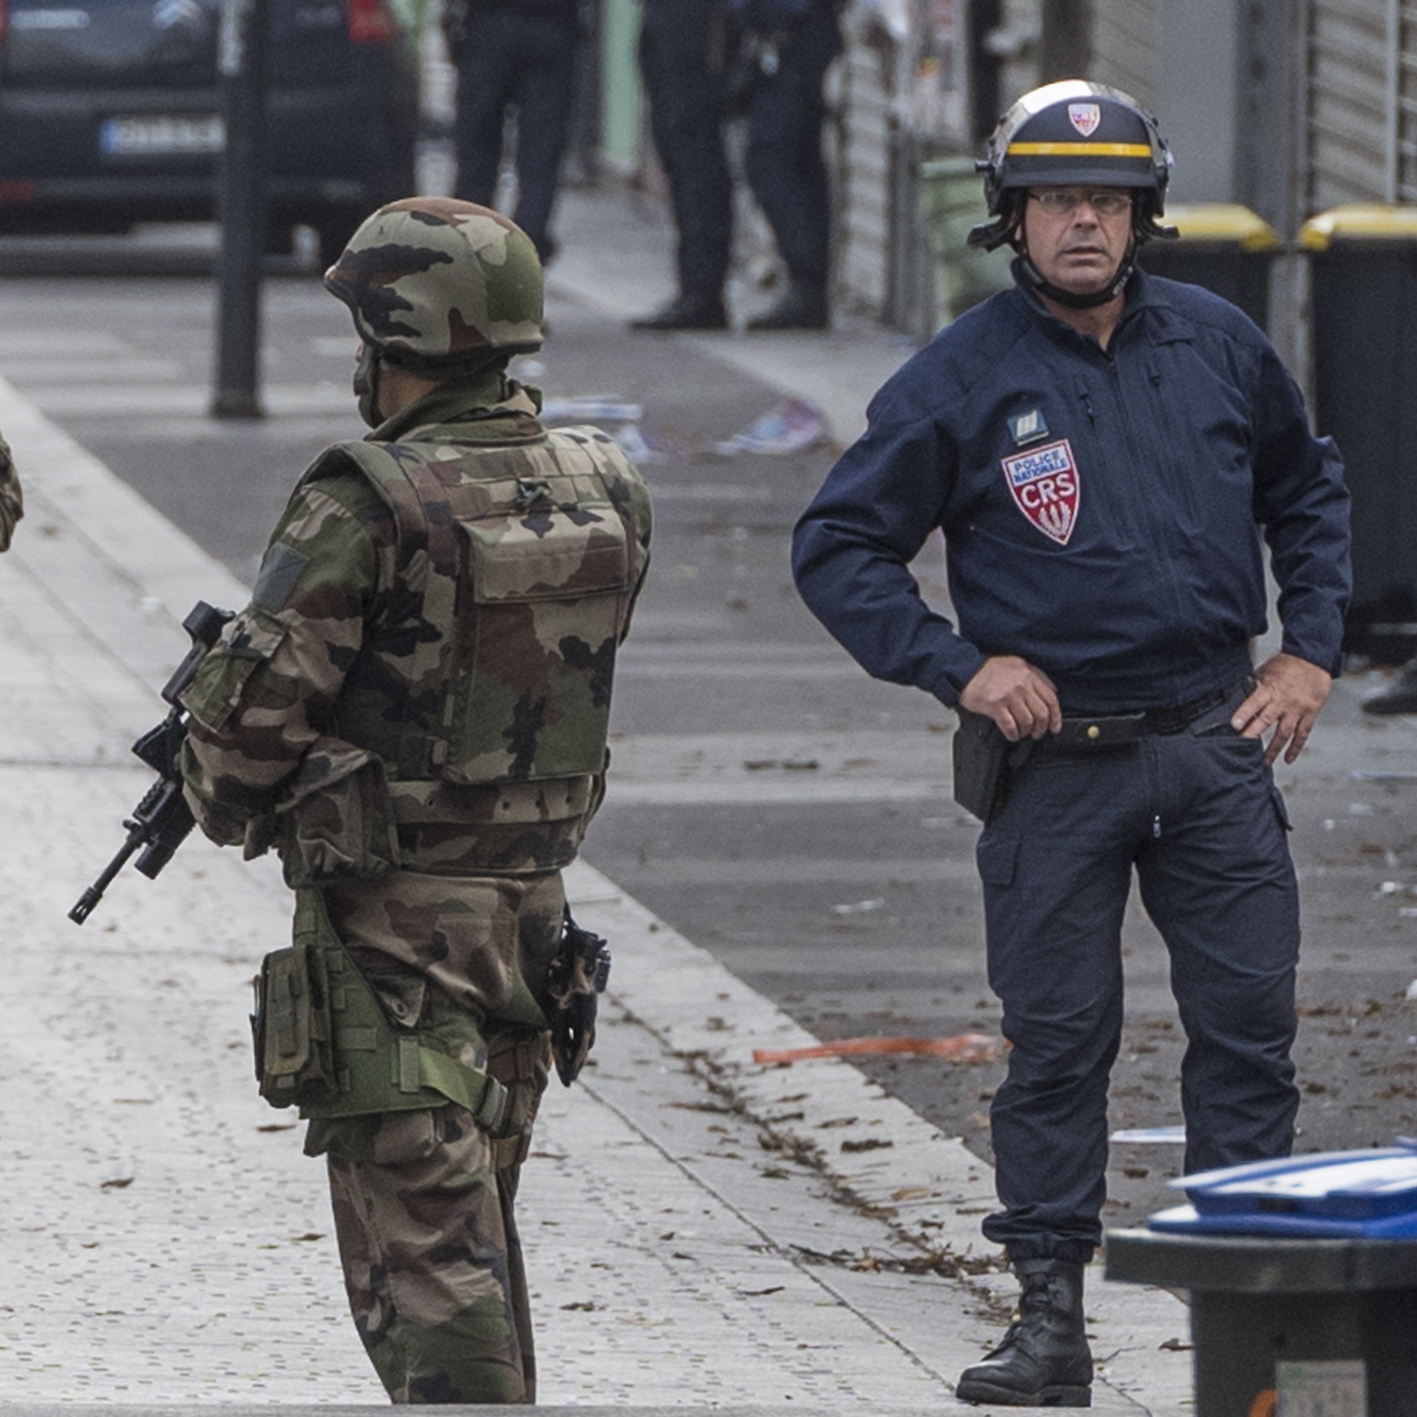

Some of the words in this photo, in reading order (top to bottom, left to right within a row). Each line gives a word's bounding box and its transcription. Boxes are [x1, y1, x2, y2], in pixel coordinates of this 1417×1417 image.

[1014, 451, 1060, 473] POLICE
[1014, 458, 1068, 482] NATIONALE
[1021, 475, 1075, 508] CRS
